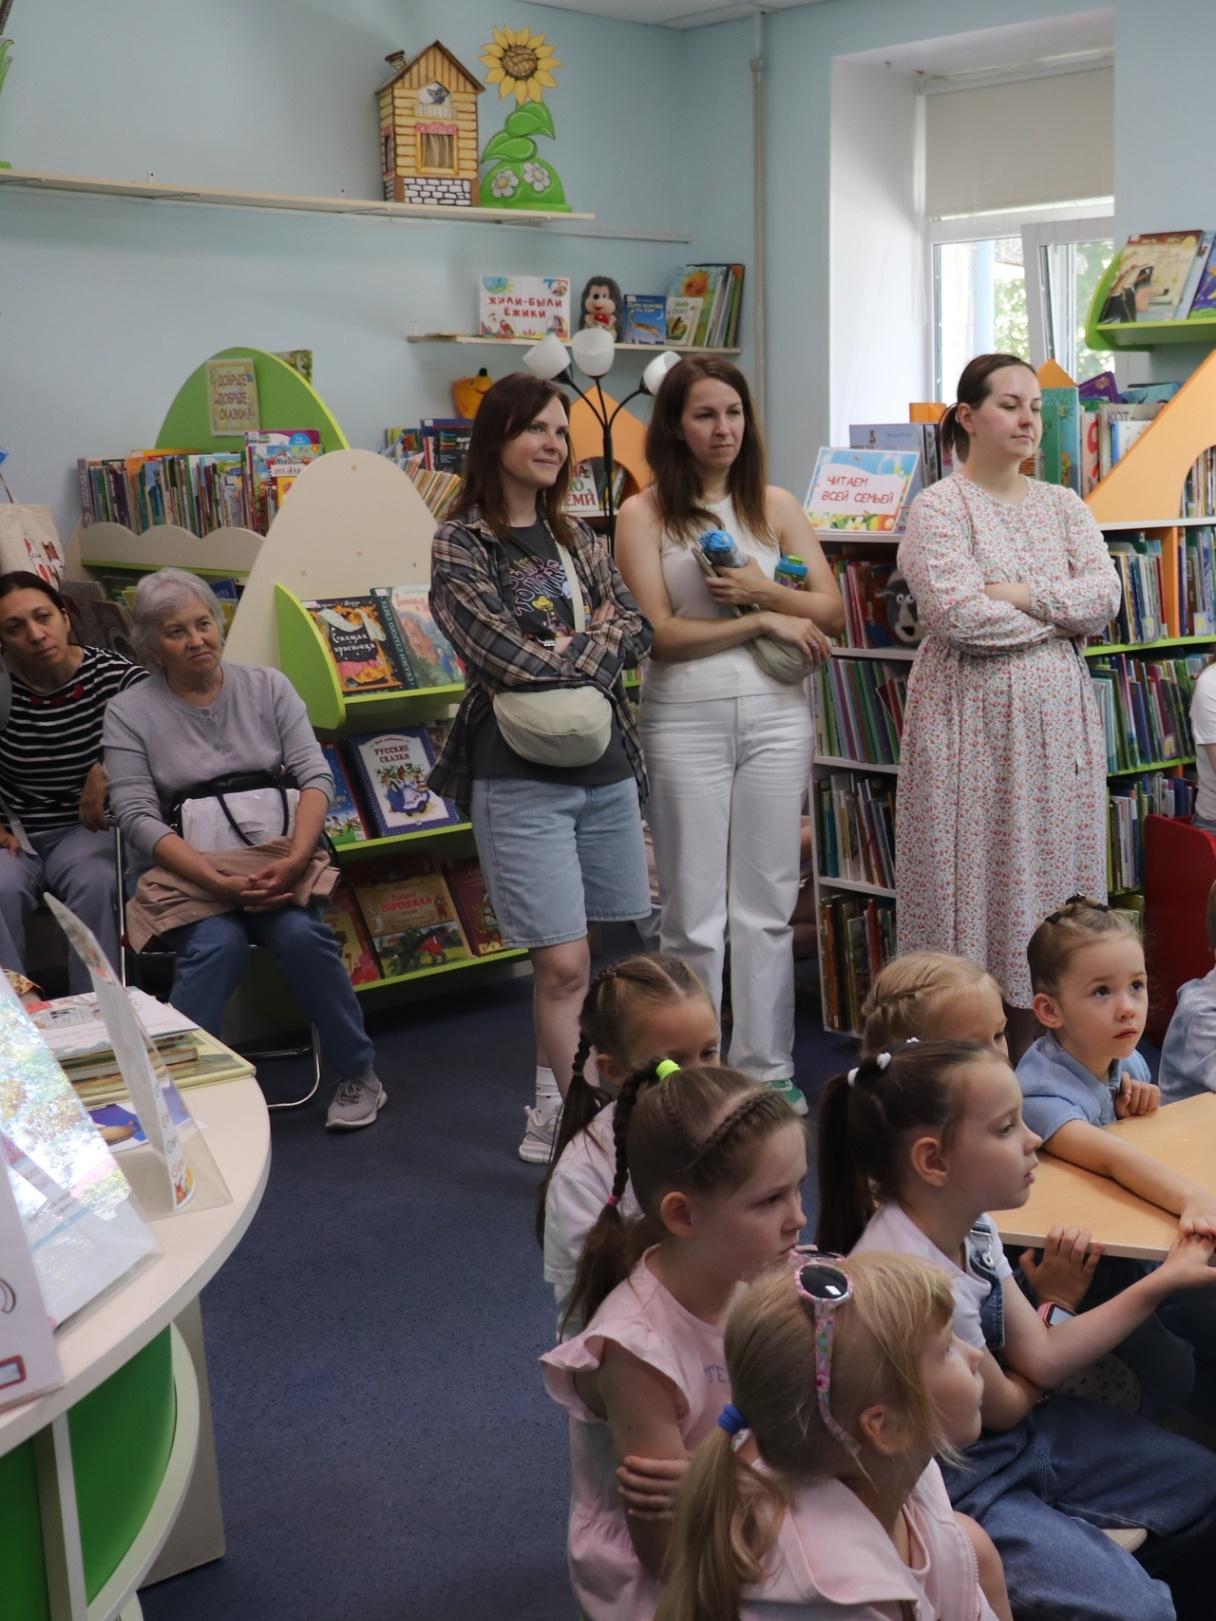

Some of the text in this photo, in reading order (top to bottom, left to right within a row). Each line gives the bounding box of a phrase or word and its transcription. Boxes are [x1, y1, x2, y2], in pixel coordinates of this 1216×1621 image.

[487, 297, 563, 308] ЖИЛИ-БЫЛИ
[503, 306, 547, 318] ЁЖИКИ
[826, 476, 869, 488] ЧИТАЕМ
[821, 490, 895, 504] ВСЕЙ СЕМЬЕЙ
[374, 745, 410, 756] РУССКИЕ
[379, 754, 411, 764] СКАЗКИ
